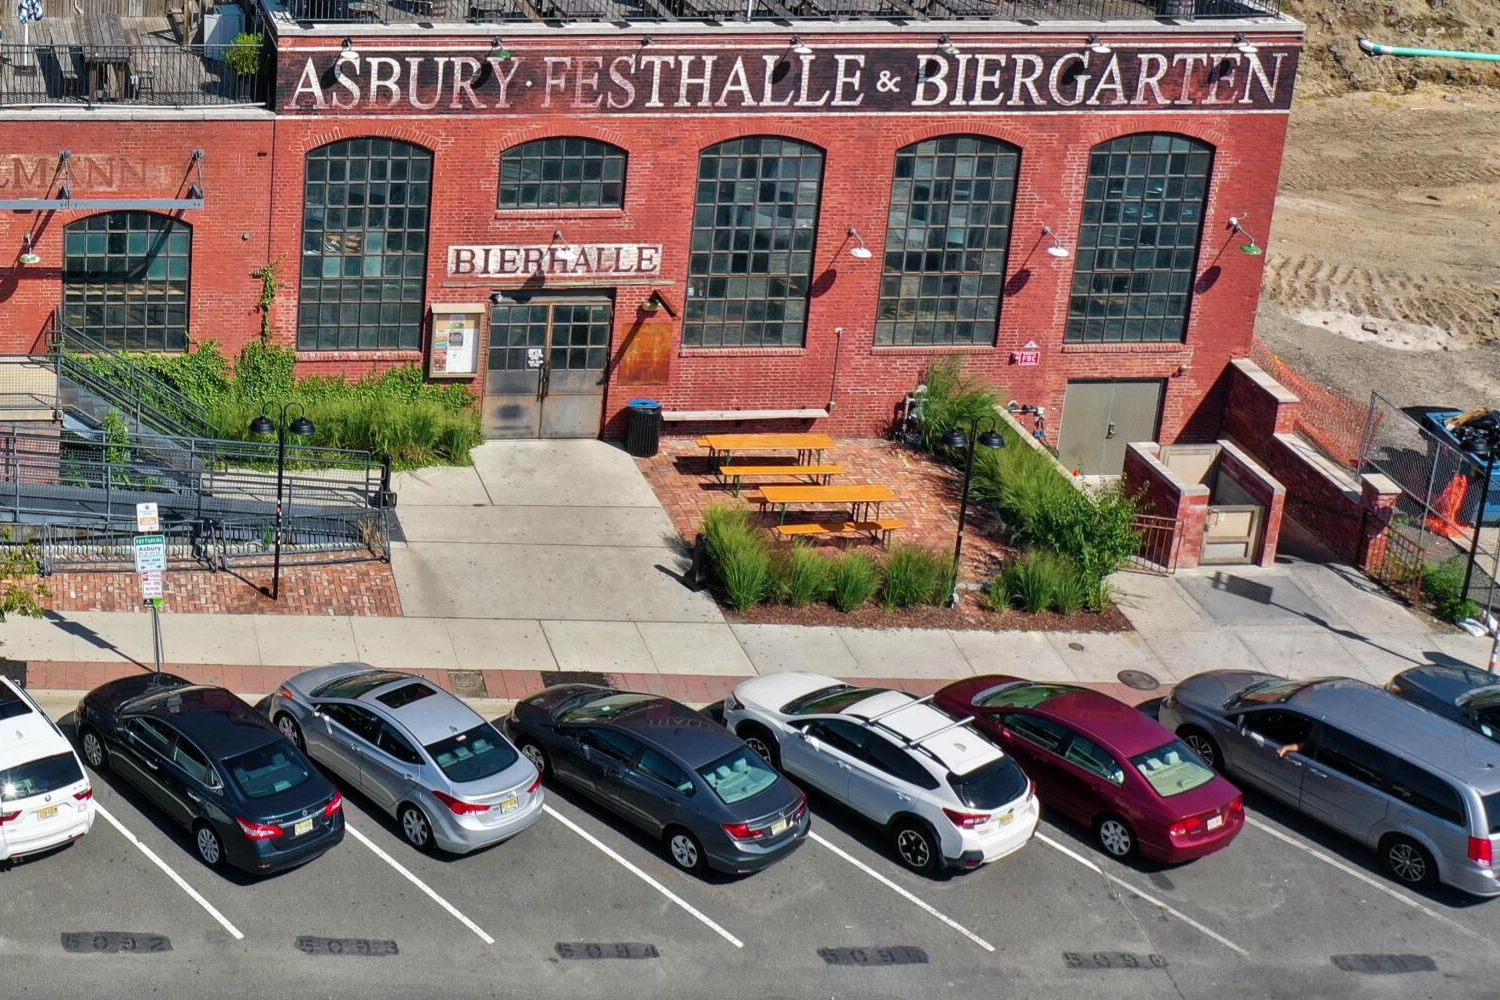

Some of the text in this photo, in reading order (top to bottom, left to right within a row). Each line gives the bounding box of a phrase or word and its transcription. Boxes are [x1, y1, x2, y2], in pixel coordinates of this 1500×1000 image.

[283, 51, 1288, 110] ASBURY FESTHALLE & BIERGARTEN
[452, 245, 660, 275] BIERHALLE
